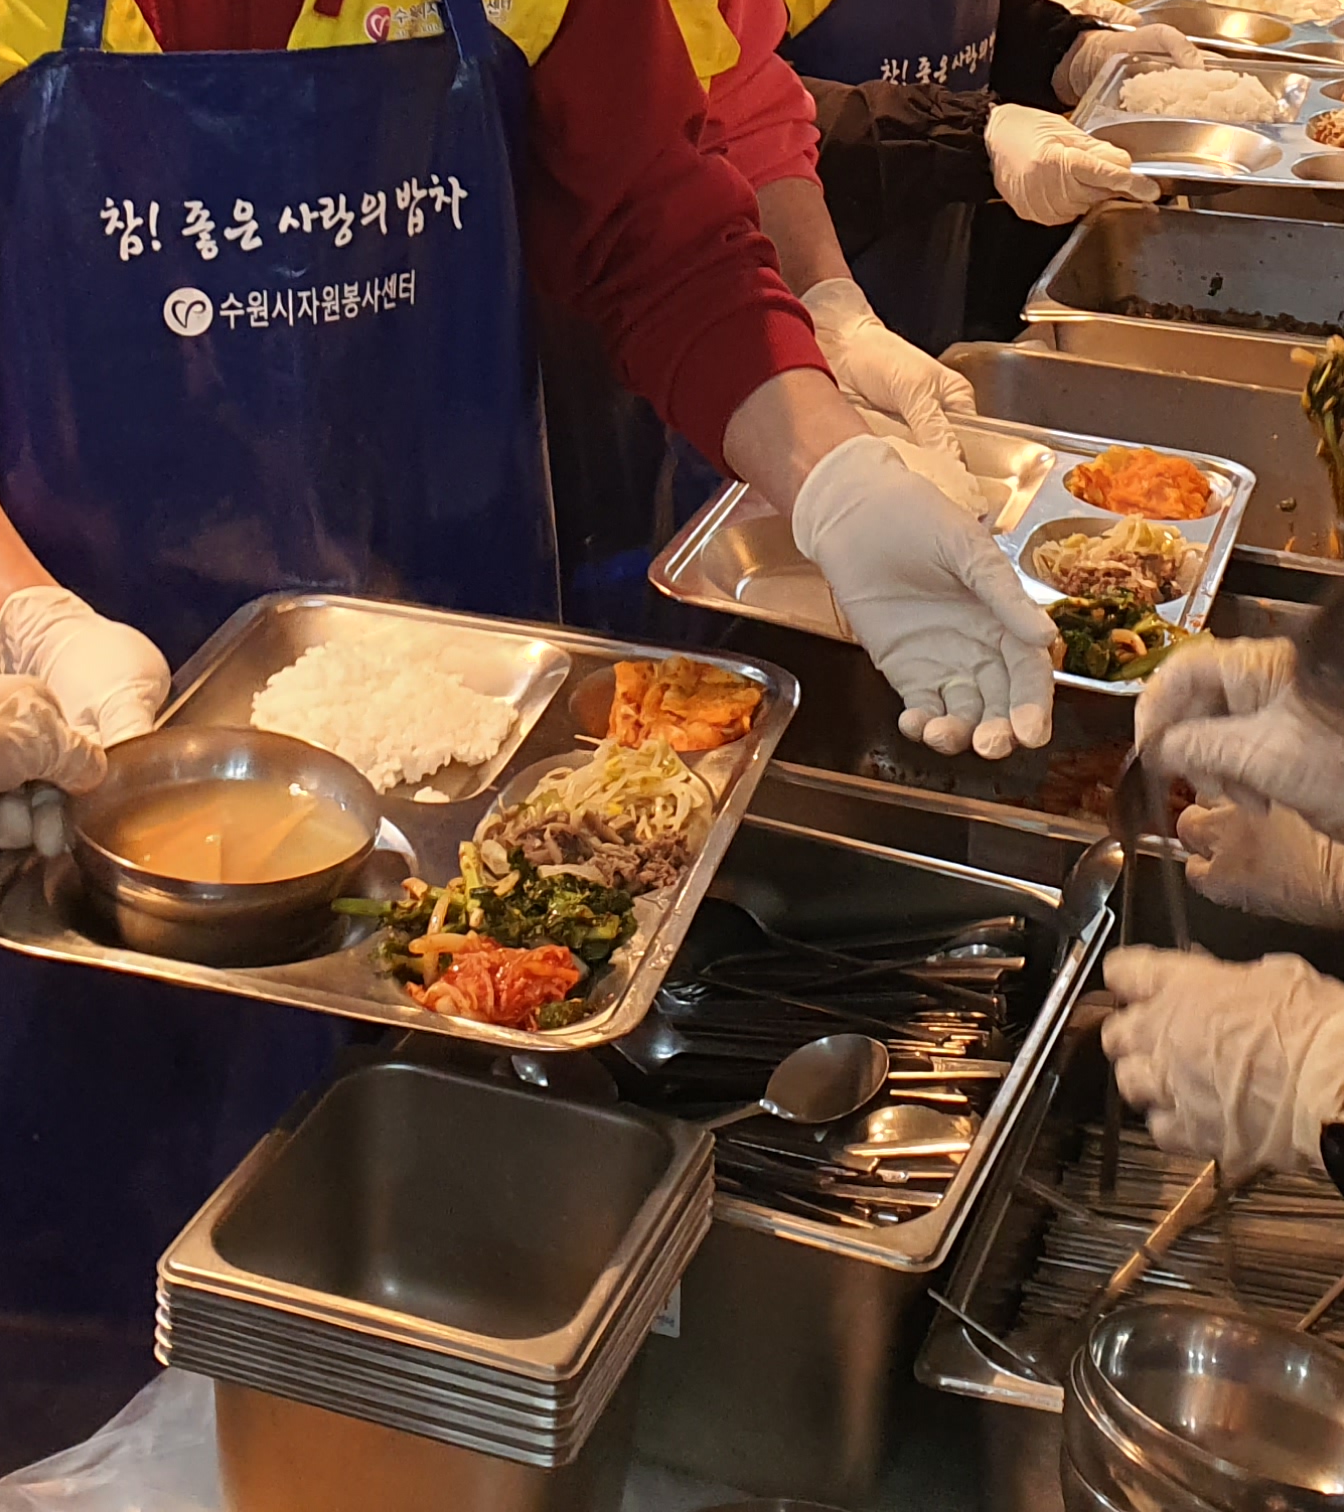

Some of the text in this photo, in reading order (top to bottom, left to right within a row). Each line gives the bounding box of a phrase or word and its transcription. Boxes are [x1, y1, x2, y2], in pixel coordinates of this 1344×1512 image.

[100, 173, 468, 261] 참! 좋은 사랑의 밥차
[219, 269, 416, 330] 수원시자원봉사센터
